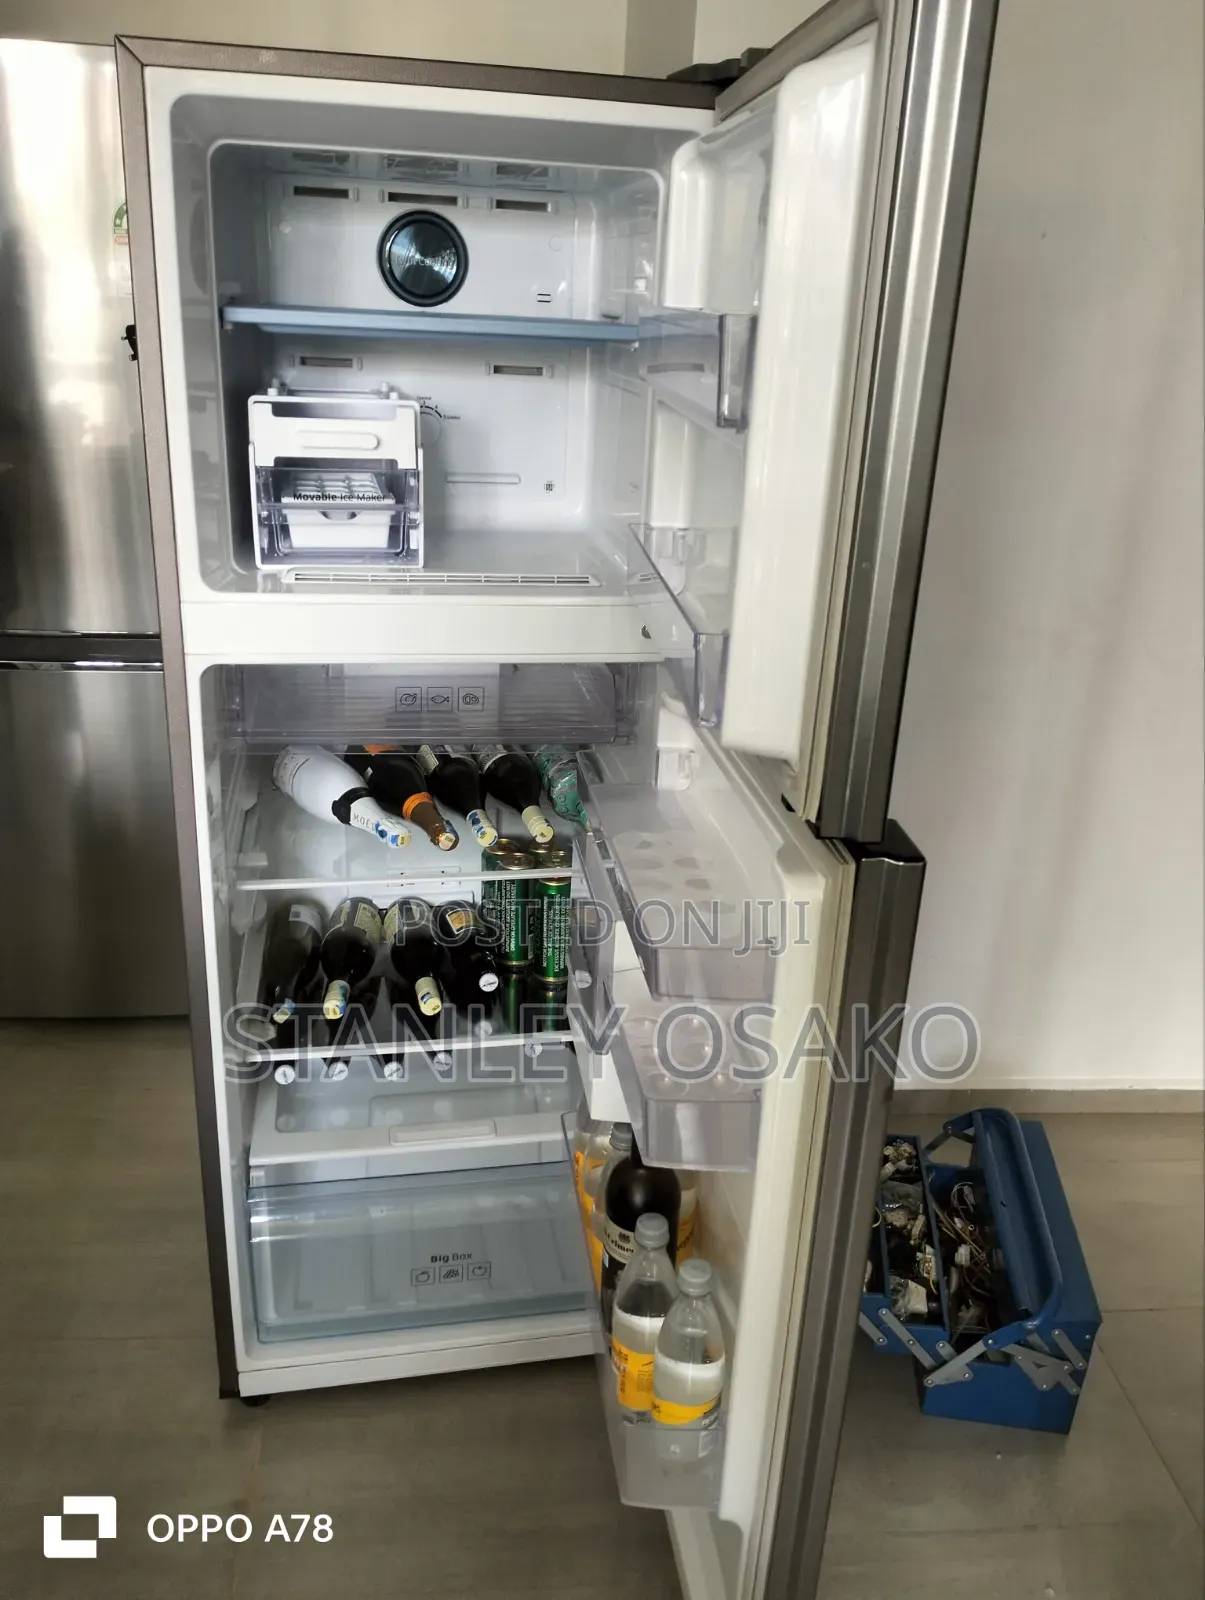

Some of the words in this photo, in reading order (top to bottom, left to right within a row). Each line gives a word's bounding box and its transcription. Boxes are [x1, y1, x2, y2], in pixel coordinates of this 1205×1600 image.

[293, 492, 337, 501] Movable
[340, 492, 354, 502] Ice
[356, 493, 386, 502] Maker
[430, 1254, 450, 1264] Big
[451, 1252, 473, 1262] Box
